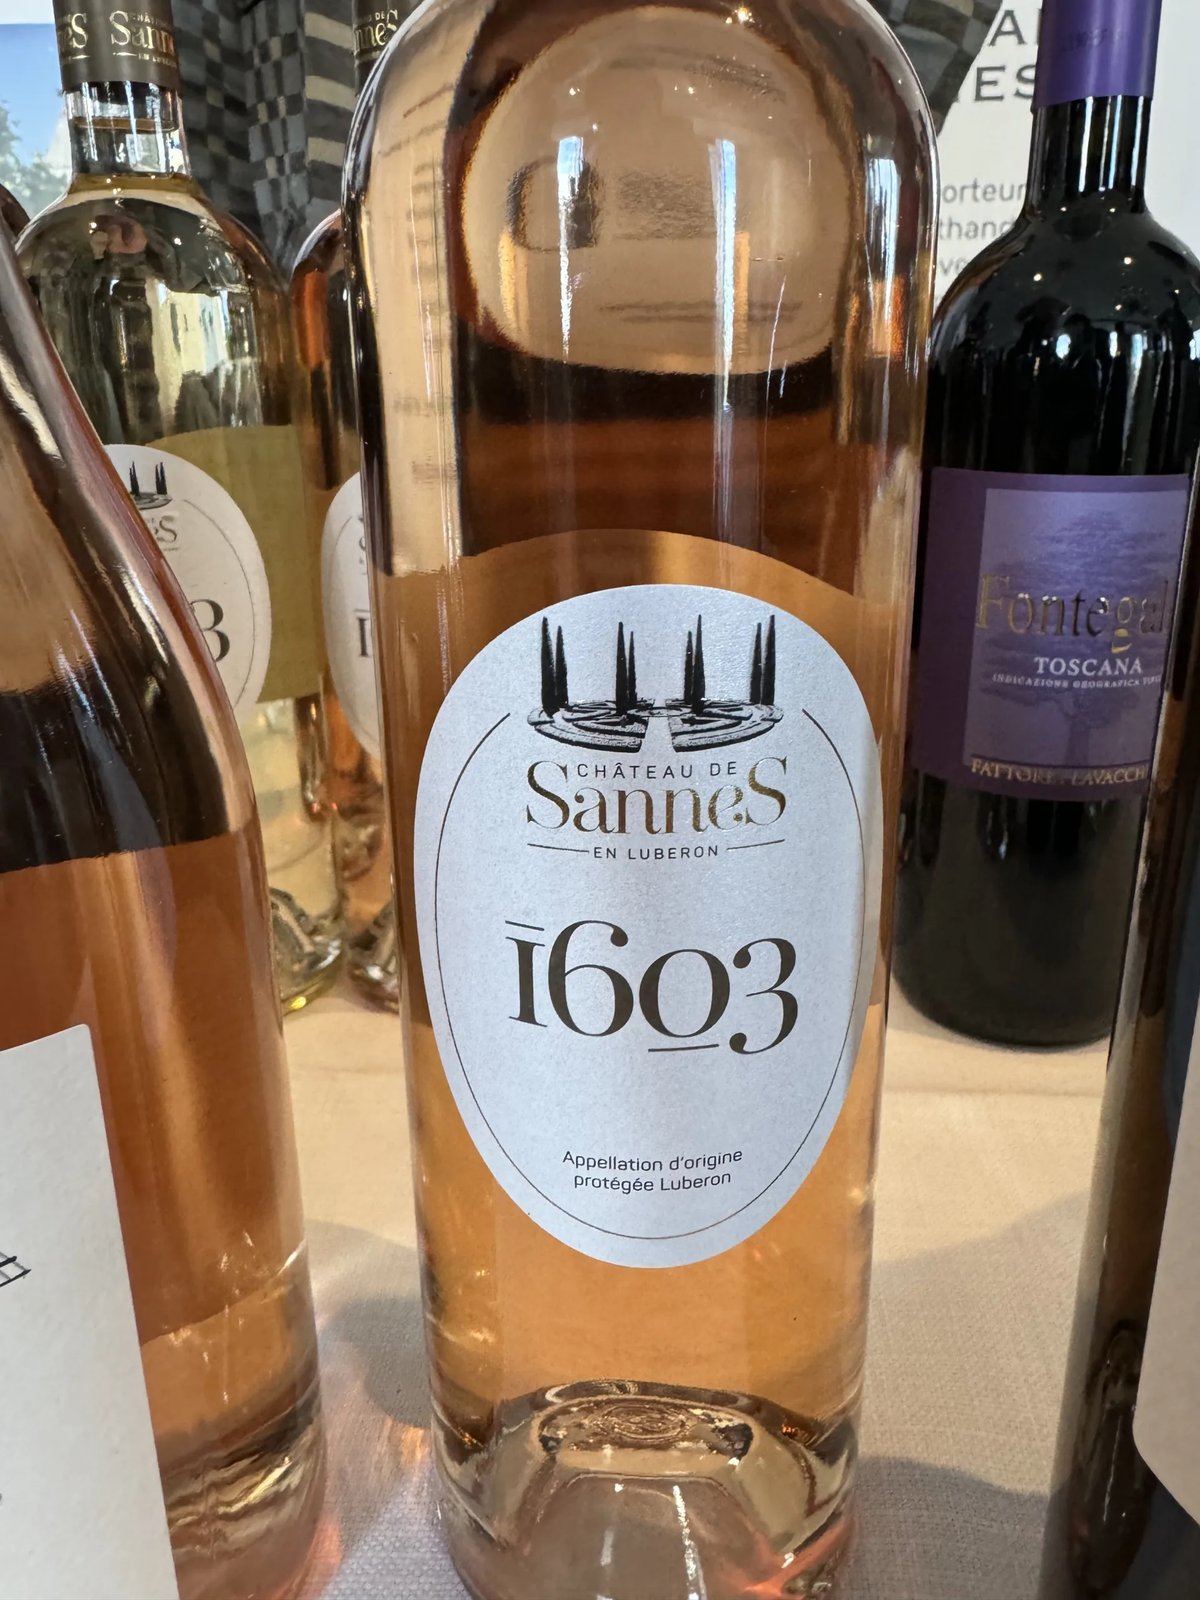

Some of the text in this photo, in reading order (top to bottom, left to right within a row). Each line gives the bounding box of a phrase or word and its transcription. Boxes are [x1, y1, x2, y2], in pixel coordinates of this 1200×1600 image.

[1034, 656, 1144, 677] TOSCANA
[577, 761, 738, 779] CHÂTEAU DE
[593, 845, 719, 861] EN LUBERON
[504, 919, 799, 1055] 1603
[562, 1150, 743, 1172] Appellation d'origine
[574, 1173, 731, 1195] protégée Luberon
